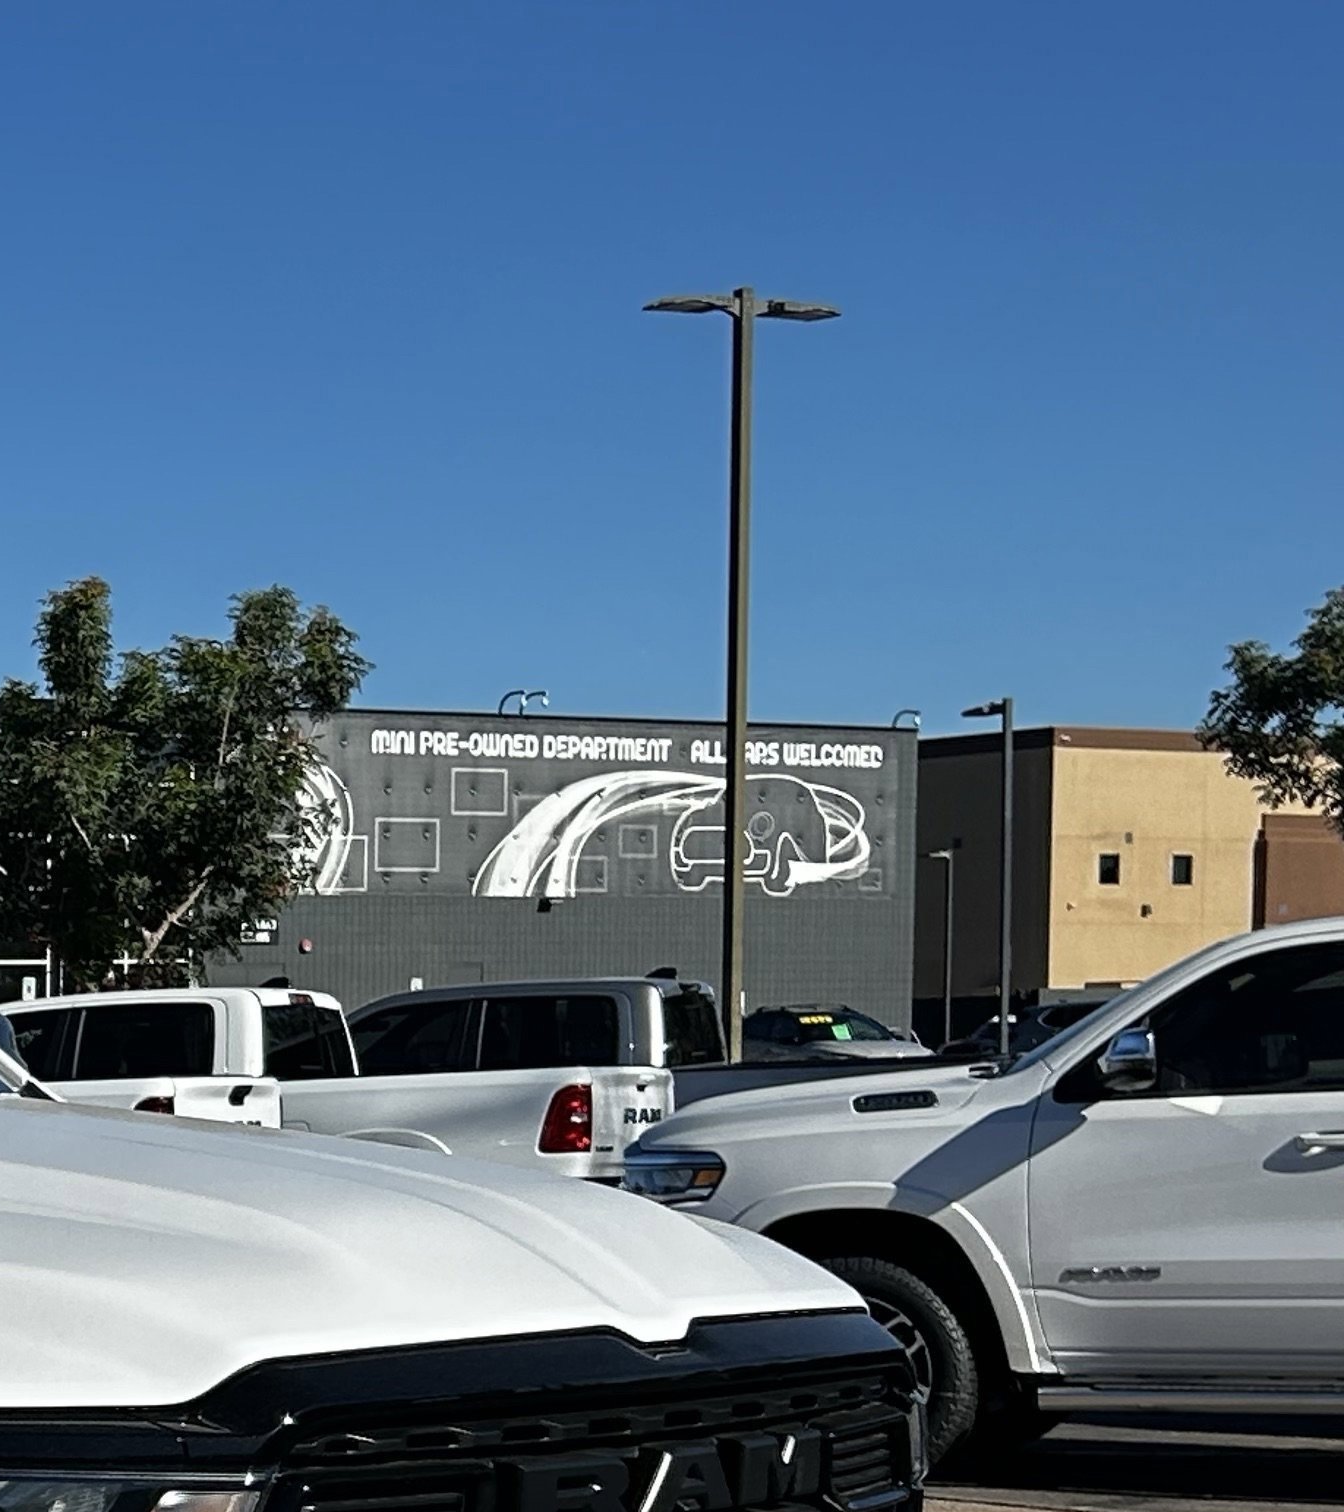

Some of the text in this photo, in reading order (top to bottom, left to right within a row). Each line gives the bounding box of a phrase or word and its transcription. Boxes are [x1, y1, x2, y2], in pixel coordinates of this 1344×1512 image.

[370, 729, 883, 767] MINI PRE-OWNED DEPARTMENT ALL ARS WELCOMED
[623, 1108, 662, 1124] RAM
